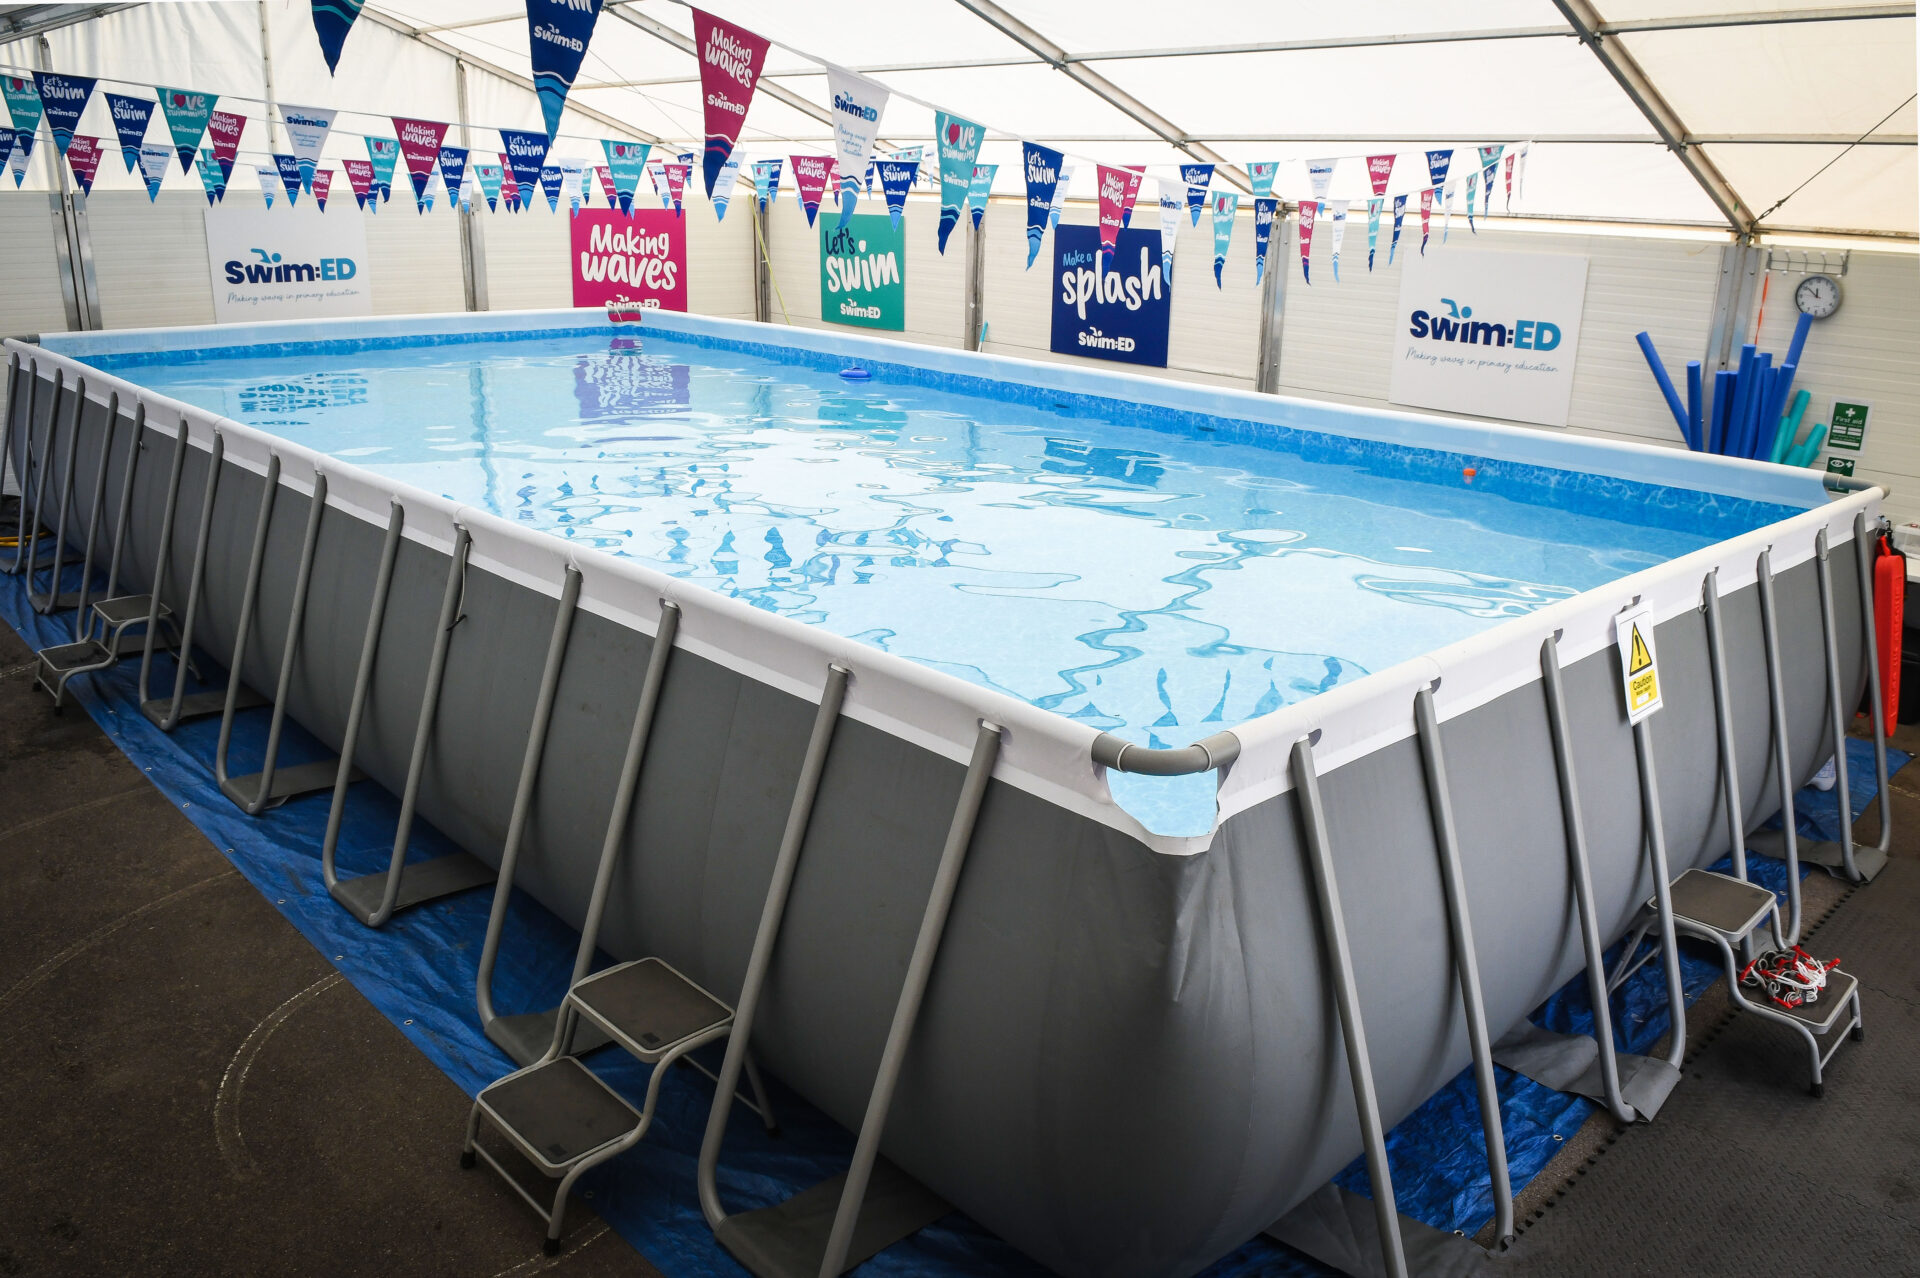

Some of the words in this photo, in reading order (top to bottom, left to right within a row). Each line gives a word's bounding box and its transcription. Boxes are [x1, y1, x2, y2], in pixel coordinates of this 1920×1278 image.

[534, 25, 583, 52] Swim:ED
[711, 26, 752, 67] Making
[705, 41, 753, 88] waves
[42, 76, 62, 87] Let's
[113, 99, 129, 109] Let's
[708, 93, 745, 116] Swim:ED
[834, 92, 878, 122] Swim:ED
[211, 111, 237, 125] Making
[209, 120, 239, 137] waves
[405, 123, 436, 137] Making
[401, 131, 438, 149] waves
[509, 136, 526, 145] Let's
[942, 146, 975, 163] swimming
[1027, 151, 1042, 166] Let's
[797, 165, 826, 180] waves
[800, 158, 825, 170] Making
[882, 164, 897, 173] Let's
[1105, 172, 1125, 194] Making
[590, 223, 670, 260] Making
[825, 227, 855, 256] Let's
[826, 239, 900, 293] swim
[1063, 250, 1085, 267] Make
[1086, 253, 1093, 263] a
[225, 254, 357, 285] Swim:ED
[581, 251, 678, 291] waves
[1062, 246, 1162, 321] splash
[227, 292, 258, 305] Making
[295, 292, 324, 303] primary
[326, 288, 360, 297] education
[840, 301, 881, 319] Swim:ED
[1409, 307, 1562, 352] Swim:ED
[1078, 331, 1136, 352] Swim:ED
[1405, 346, 1438, 366] Making
[1440, 355, 1466, 366] waves
[1467, 357, 1477, 365] in
[1477, 358, 1512, 374] primary
[1514, 360, 1559, 373] education
[1835, 416, 1851, 424] First
